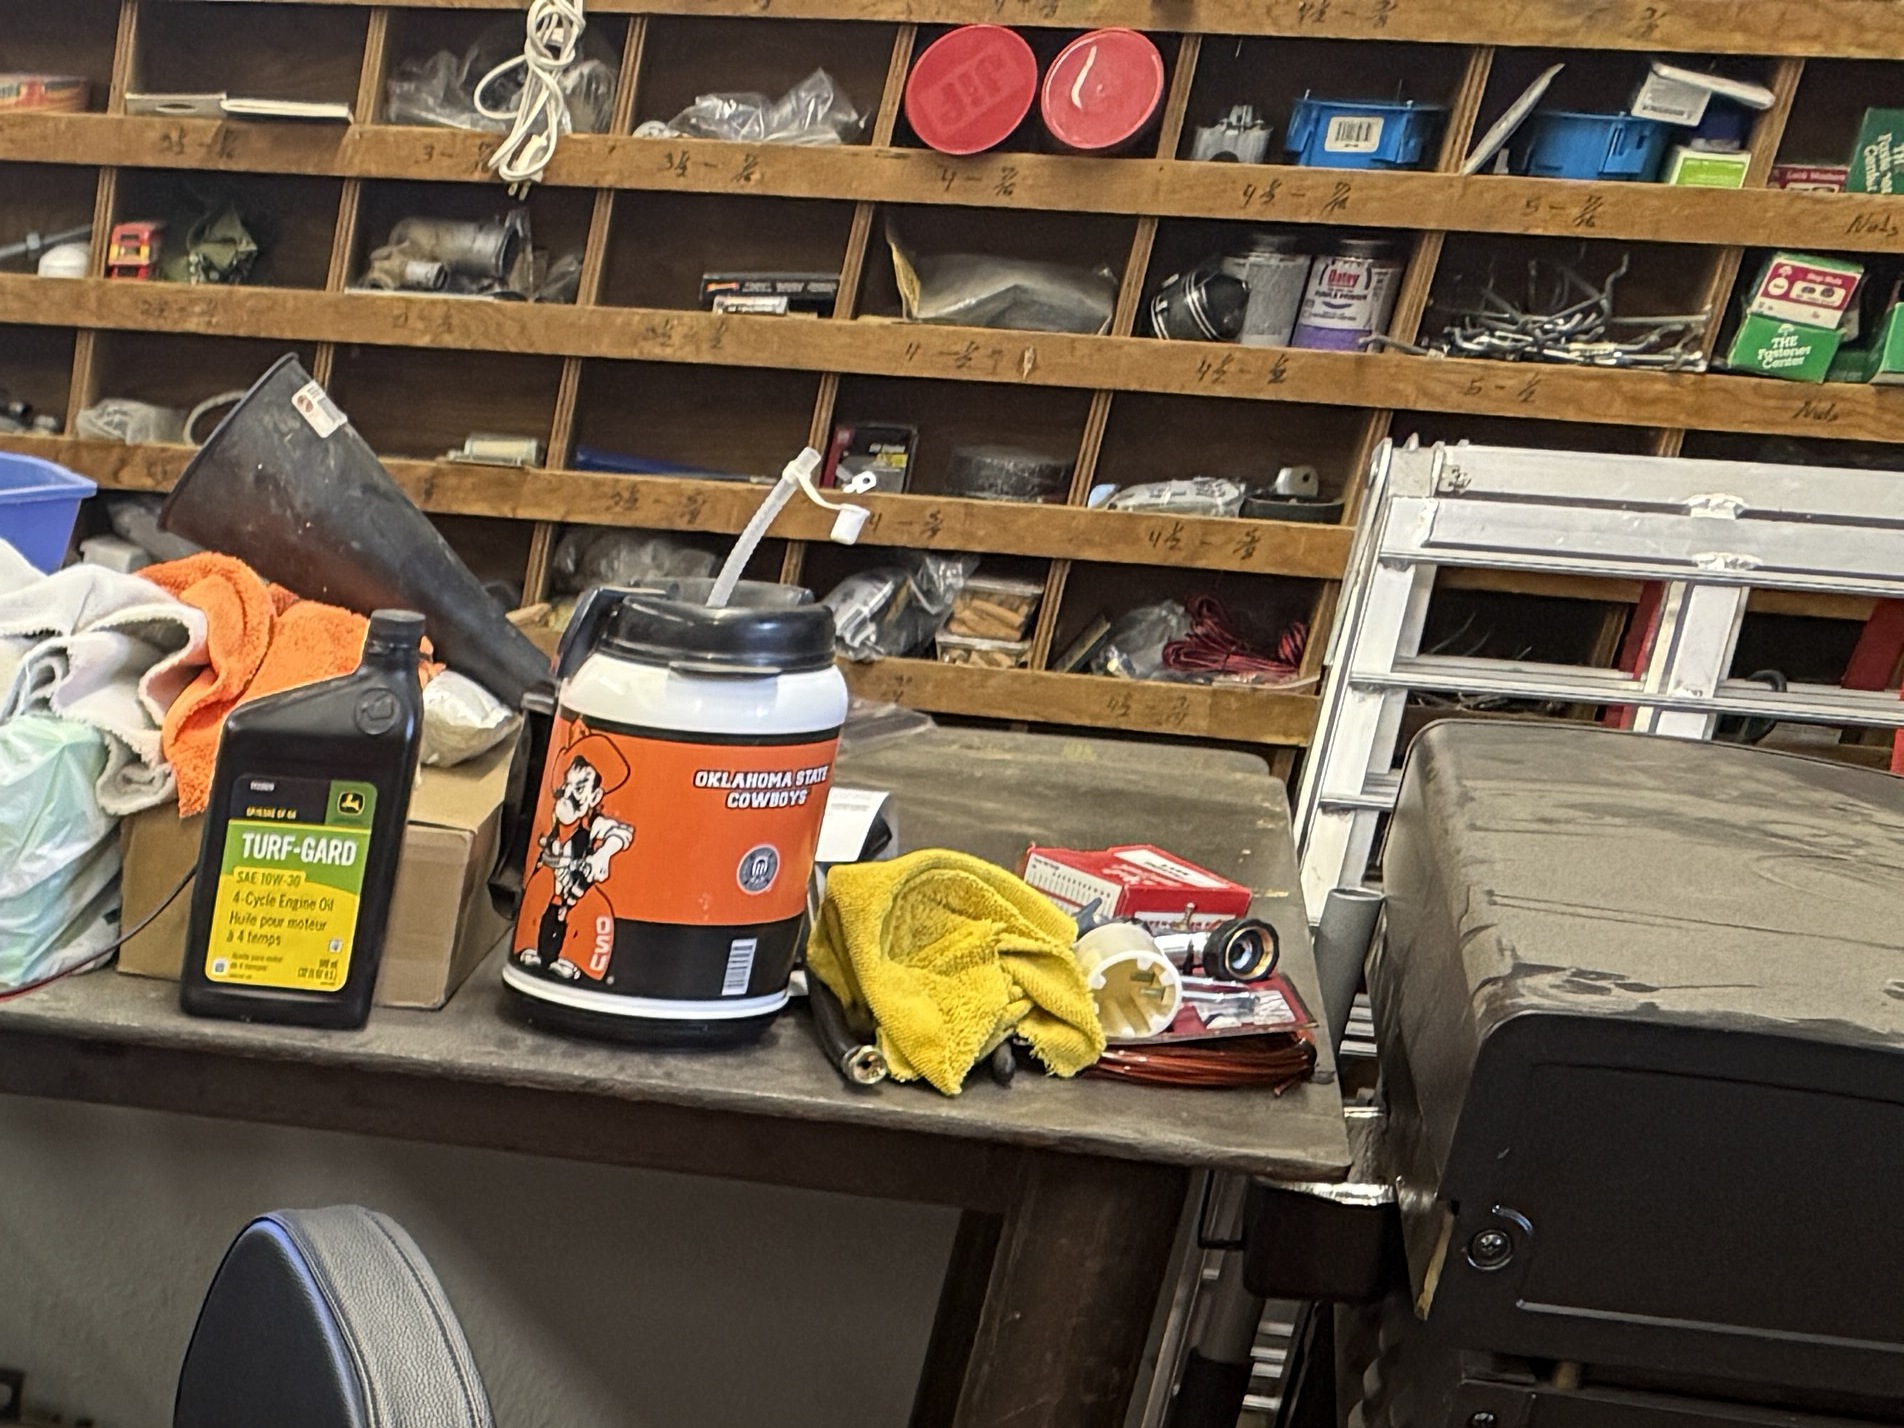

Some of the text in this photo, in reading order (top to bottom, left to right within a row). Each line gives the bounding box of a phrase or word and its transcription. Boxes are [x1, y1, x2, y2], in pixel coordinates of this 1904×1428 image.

[1770, 335, 1799, 350] THE
[694, 765, 829, 789] OKLAHOMA STATE
[726, 789, 808, 808] COWBOYS
[242, 831, 358, 867] TURF-GARD
[236, 870, 302, 887] SAE 10W-30
[232, 890, 335, 912] 4-Cycle Engine Oil
[229, 911, 328, 931] Huile pour moteur
[237, 931, 245, 944] 4
[247, 931, 282, 946] temps
[589, 915, 612, 972] OSU
